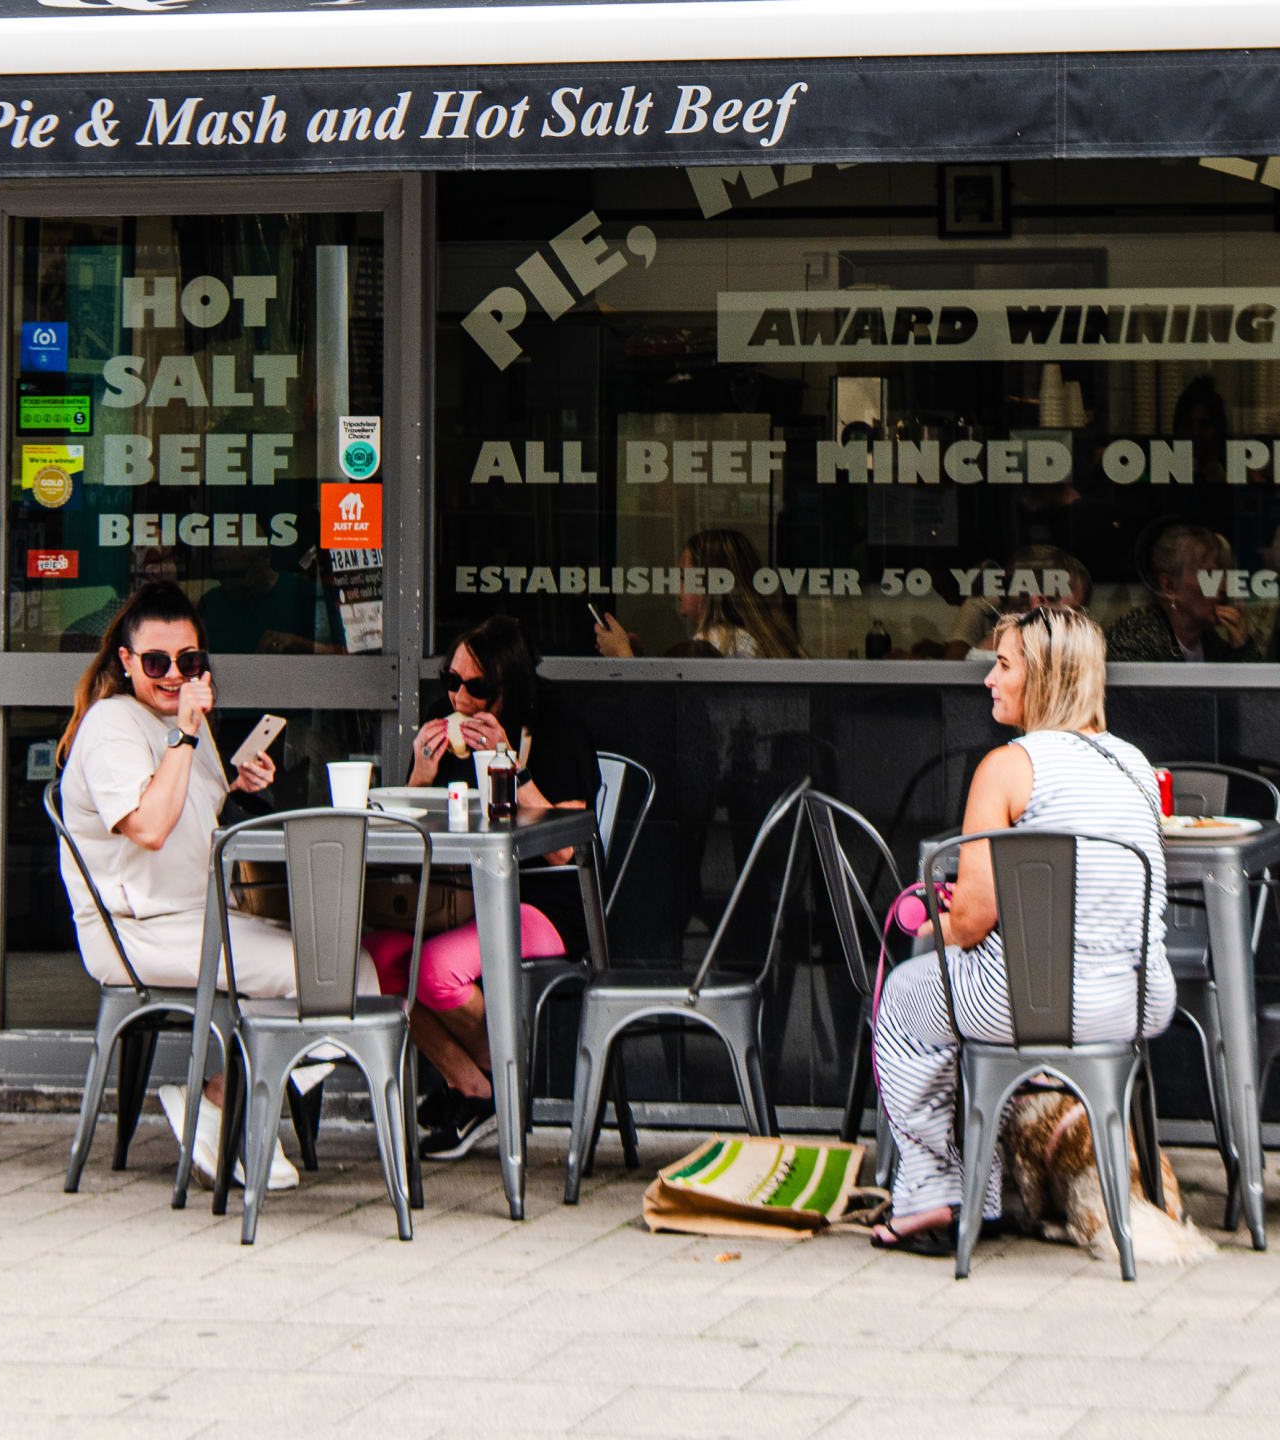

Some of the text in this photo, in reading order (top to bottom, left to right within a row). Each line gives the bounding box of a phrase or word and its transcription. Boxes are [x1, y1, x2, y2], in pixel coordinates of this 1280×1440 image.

[75, 97, 119, 148] &
[135, 94, 288, 147] Mash
[306, 91, 413, 144] and
[420, 88, 530, 140] Hot
[540, 85, 653, 139] Salt
[665, 82, 808, 147] Beef
[122, 275, 277, 328] HOT
[460, 210, 657, 371] PIE,
[748, 304, 1277, 346] AWARD WINNING
[101, 355, 298, 408] SALT
[103, 433, 294, 486] BEEF
[471, 440, 597, 484] ALL
[626, 440, 786, 484] BEEF
[817, 439, 1072, 484] MINCED
[1101, 439, 1194, 485] ON
[99, 513, 298, 547] BEIGELS
[333, 522, 370, 531] JUST EAT
[455, 565, 735, 595] ESTABLISHED
[753, 567, 862, 596] OVER
[880, 568, 932, 596] 50
